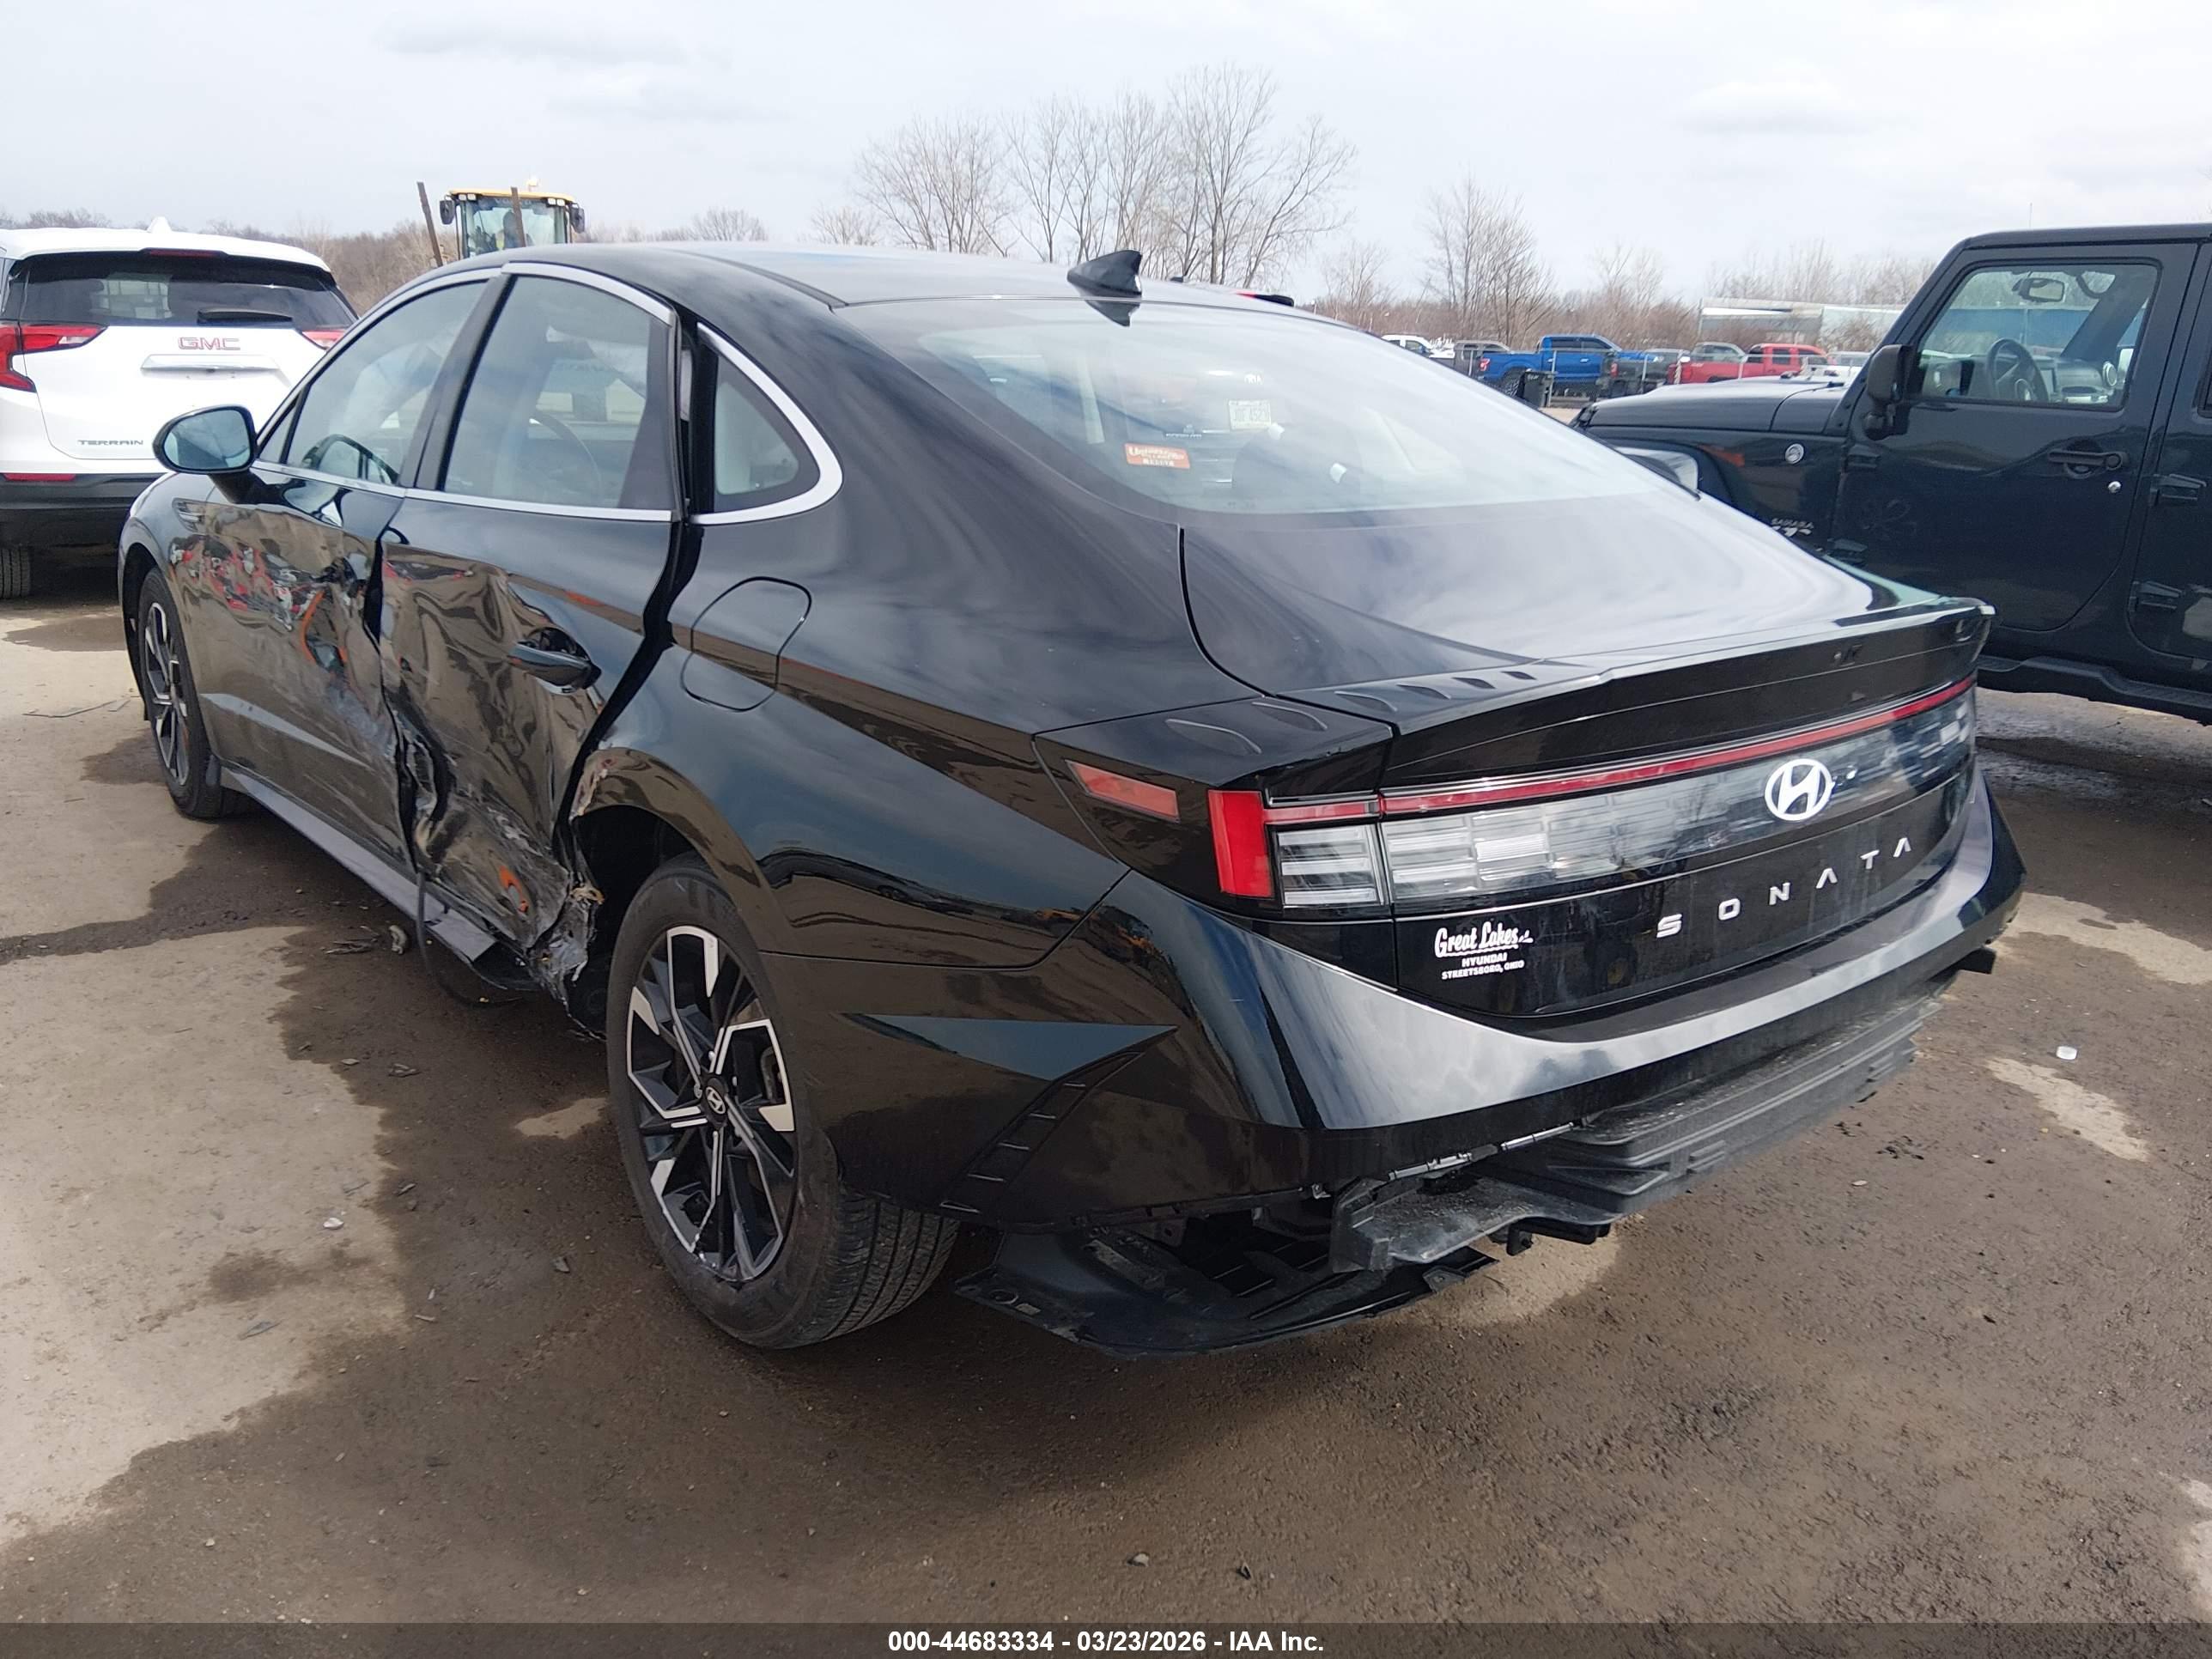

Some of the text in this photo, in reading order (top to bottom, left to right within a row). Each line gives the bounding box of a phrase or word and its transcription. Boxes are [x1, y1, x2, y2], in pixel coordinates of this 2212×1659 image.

[179, 337, 240, 350] GMC
[1656, 837, 1911, 938] SONATA
[1435, 921, 1519, 957] Great Lakes
[1462, 952, 1507, 967] HYUNDAI
[1504, 960, 1525, 970] OHIO
